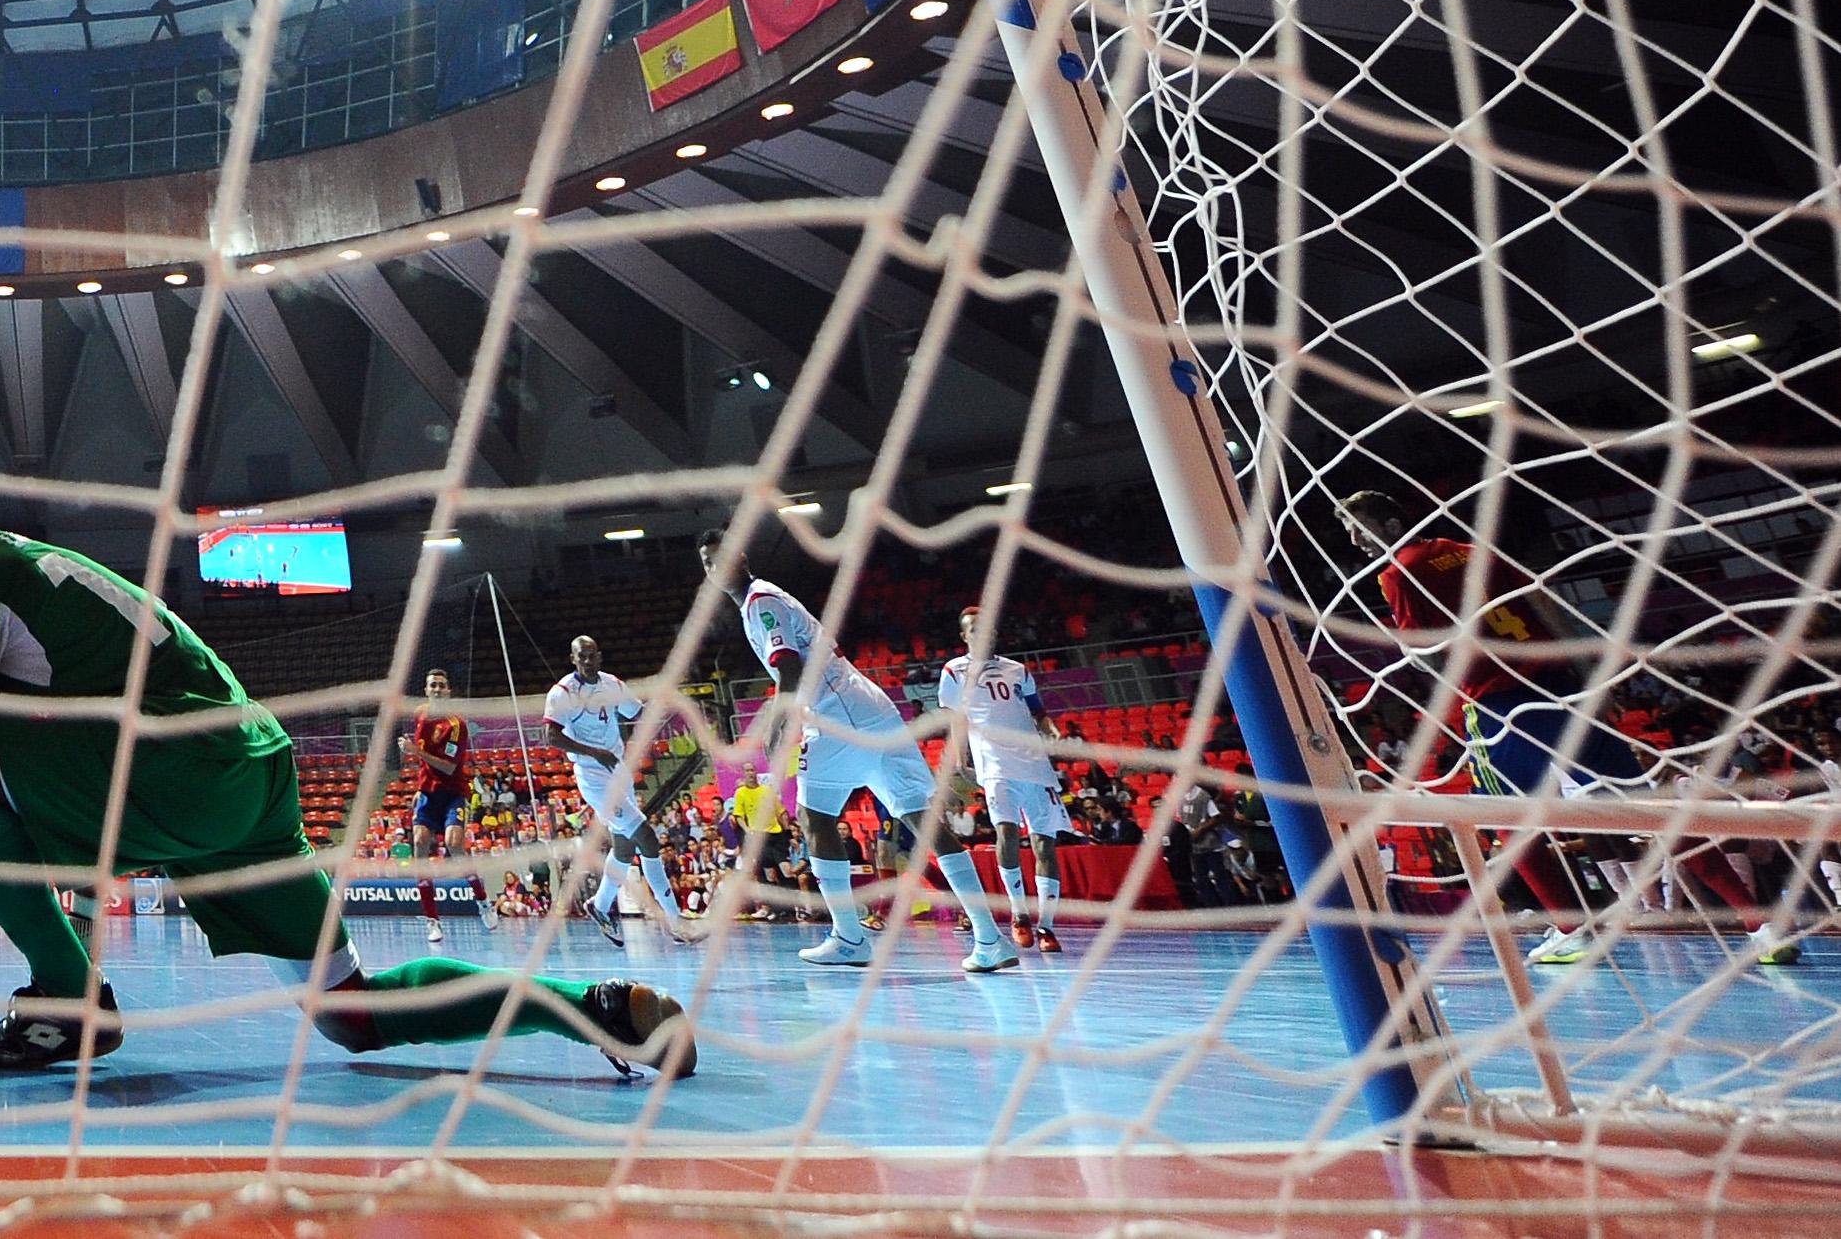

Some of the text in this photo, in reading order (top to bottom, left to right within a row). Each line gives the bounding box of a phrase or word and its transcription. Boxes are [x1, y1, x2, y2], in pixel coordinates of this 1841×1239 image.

[1482, 595, 1531, 642] 4
[986, 681, 1010, 701] 10
[598, 705, 608, 724] 4
[343, 887, 394, 902] FUTSAL
[395, 887, 447, 902] WOD
